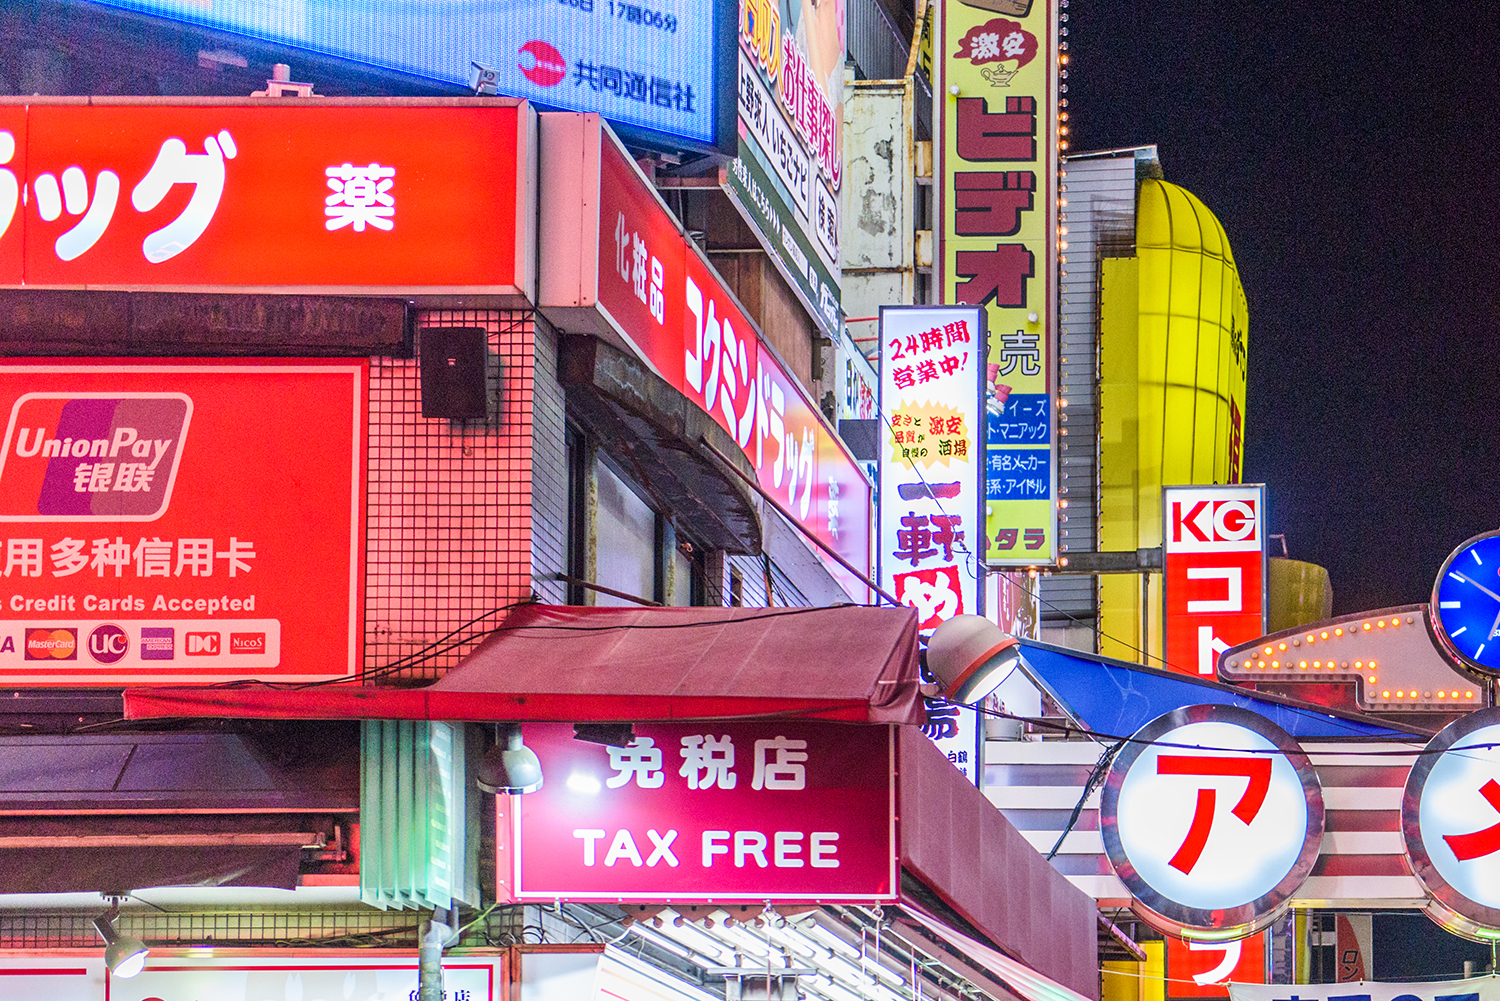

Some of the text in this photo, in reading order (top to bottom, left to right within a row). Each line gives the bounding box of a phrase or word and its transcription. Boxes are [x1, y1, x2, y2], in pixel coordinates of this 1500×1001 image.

[970, 31, 1026, 60] 激安
[573, 60, 696, 113] 共同通信社
[326, 163, 396, 232] 薬
[955, 96, 1038, 309] ビデオ
[614, 211, 664, 326] 化粧品
[889, 319, 971, 361] 24時間
[686, 276, 816, 522] コクミンドラッグ
[929, 416, 961, 436] 激安
[16, 427, 172, 469] UnionPay
[938, 439, 968, 457] 酒場
[74, 463, 155, 492] 银联
[1172, 500, 1255, 542] KG
[0, 537, 256, 578] 用多种信用卡
[10, 595, 256, 614] Credit Cards Accepted
[28, 638, 74, 650] MasterCard
[92, 632, 127, 654] UC
[189, 635, 217, 652] DC
[606, 735, 809, 791] 免税店
[573, 829, 840, 868] TAX FREE
